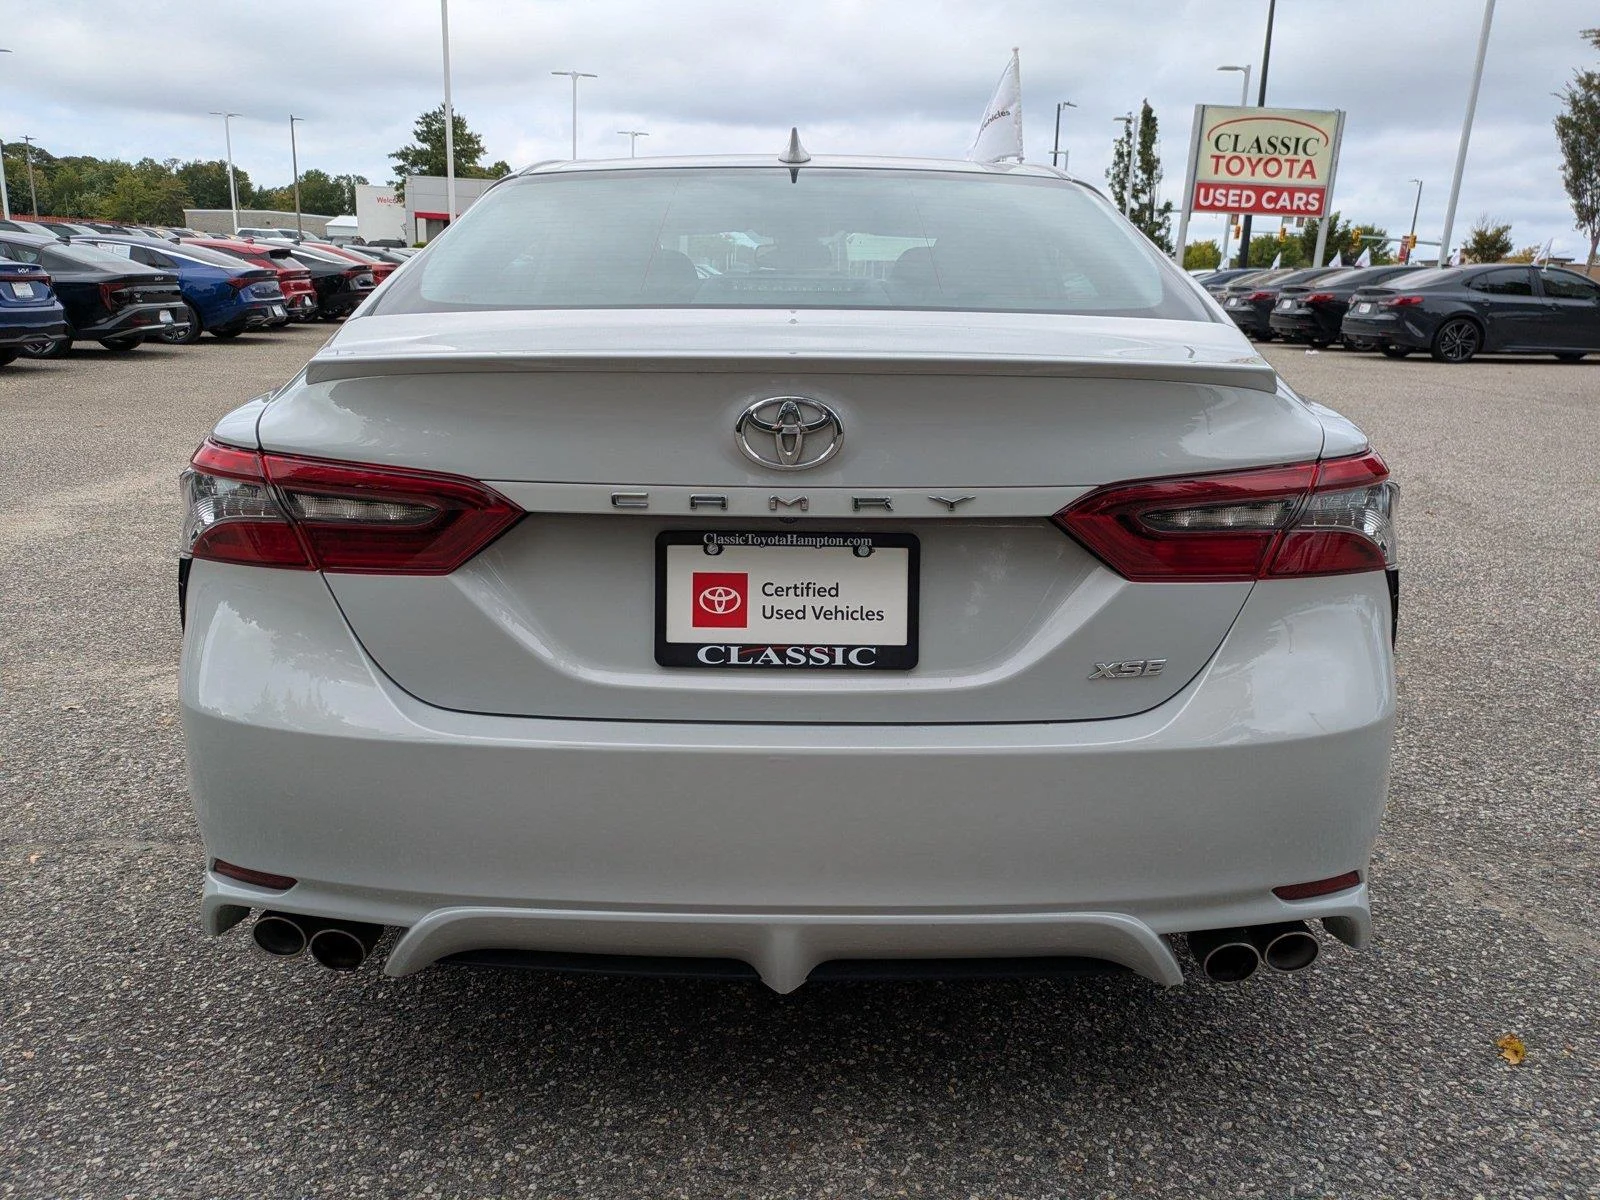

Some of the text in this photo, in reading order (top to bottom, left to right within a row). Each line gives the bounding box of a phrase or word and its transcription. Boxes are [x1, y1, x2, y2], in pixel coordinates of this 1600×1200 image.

[1214, 133, 1320, 157] CLASSIC
[1210, 154, 1318, 180] TOYOTA
[1199, 188, 1320, 211] USED CARS
[611, 492, 976, 512] CAMRY
[703, 533, 873, 549] ClassicToyotaHampton.com
[761, 582, 840, 598] Certified
[761, 605, 885, 622] Used Vehicles
[697, 645, 876, 666] CLASSIC
[1088, 659, 1167, 679] XSE
